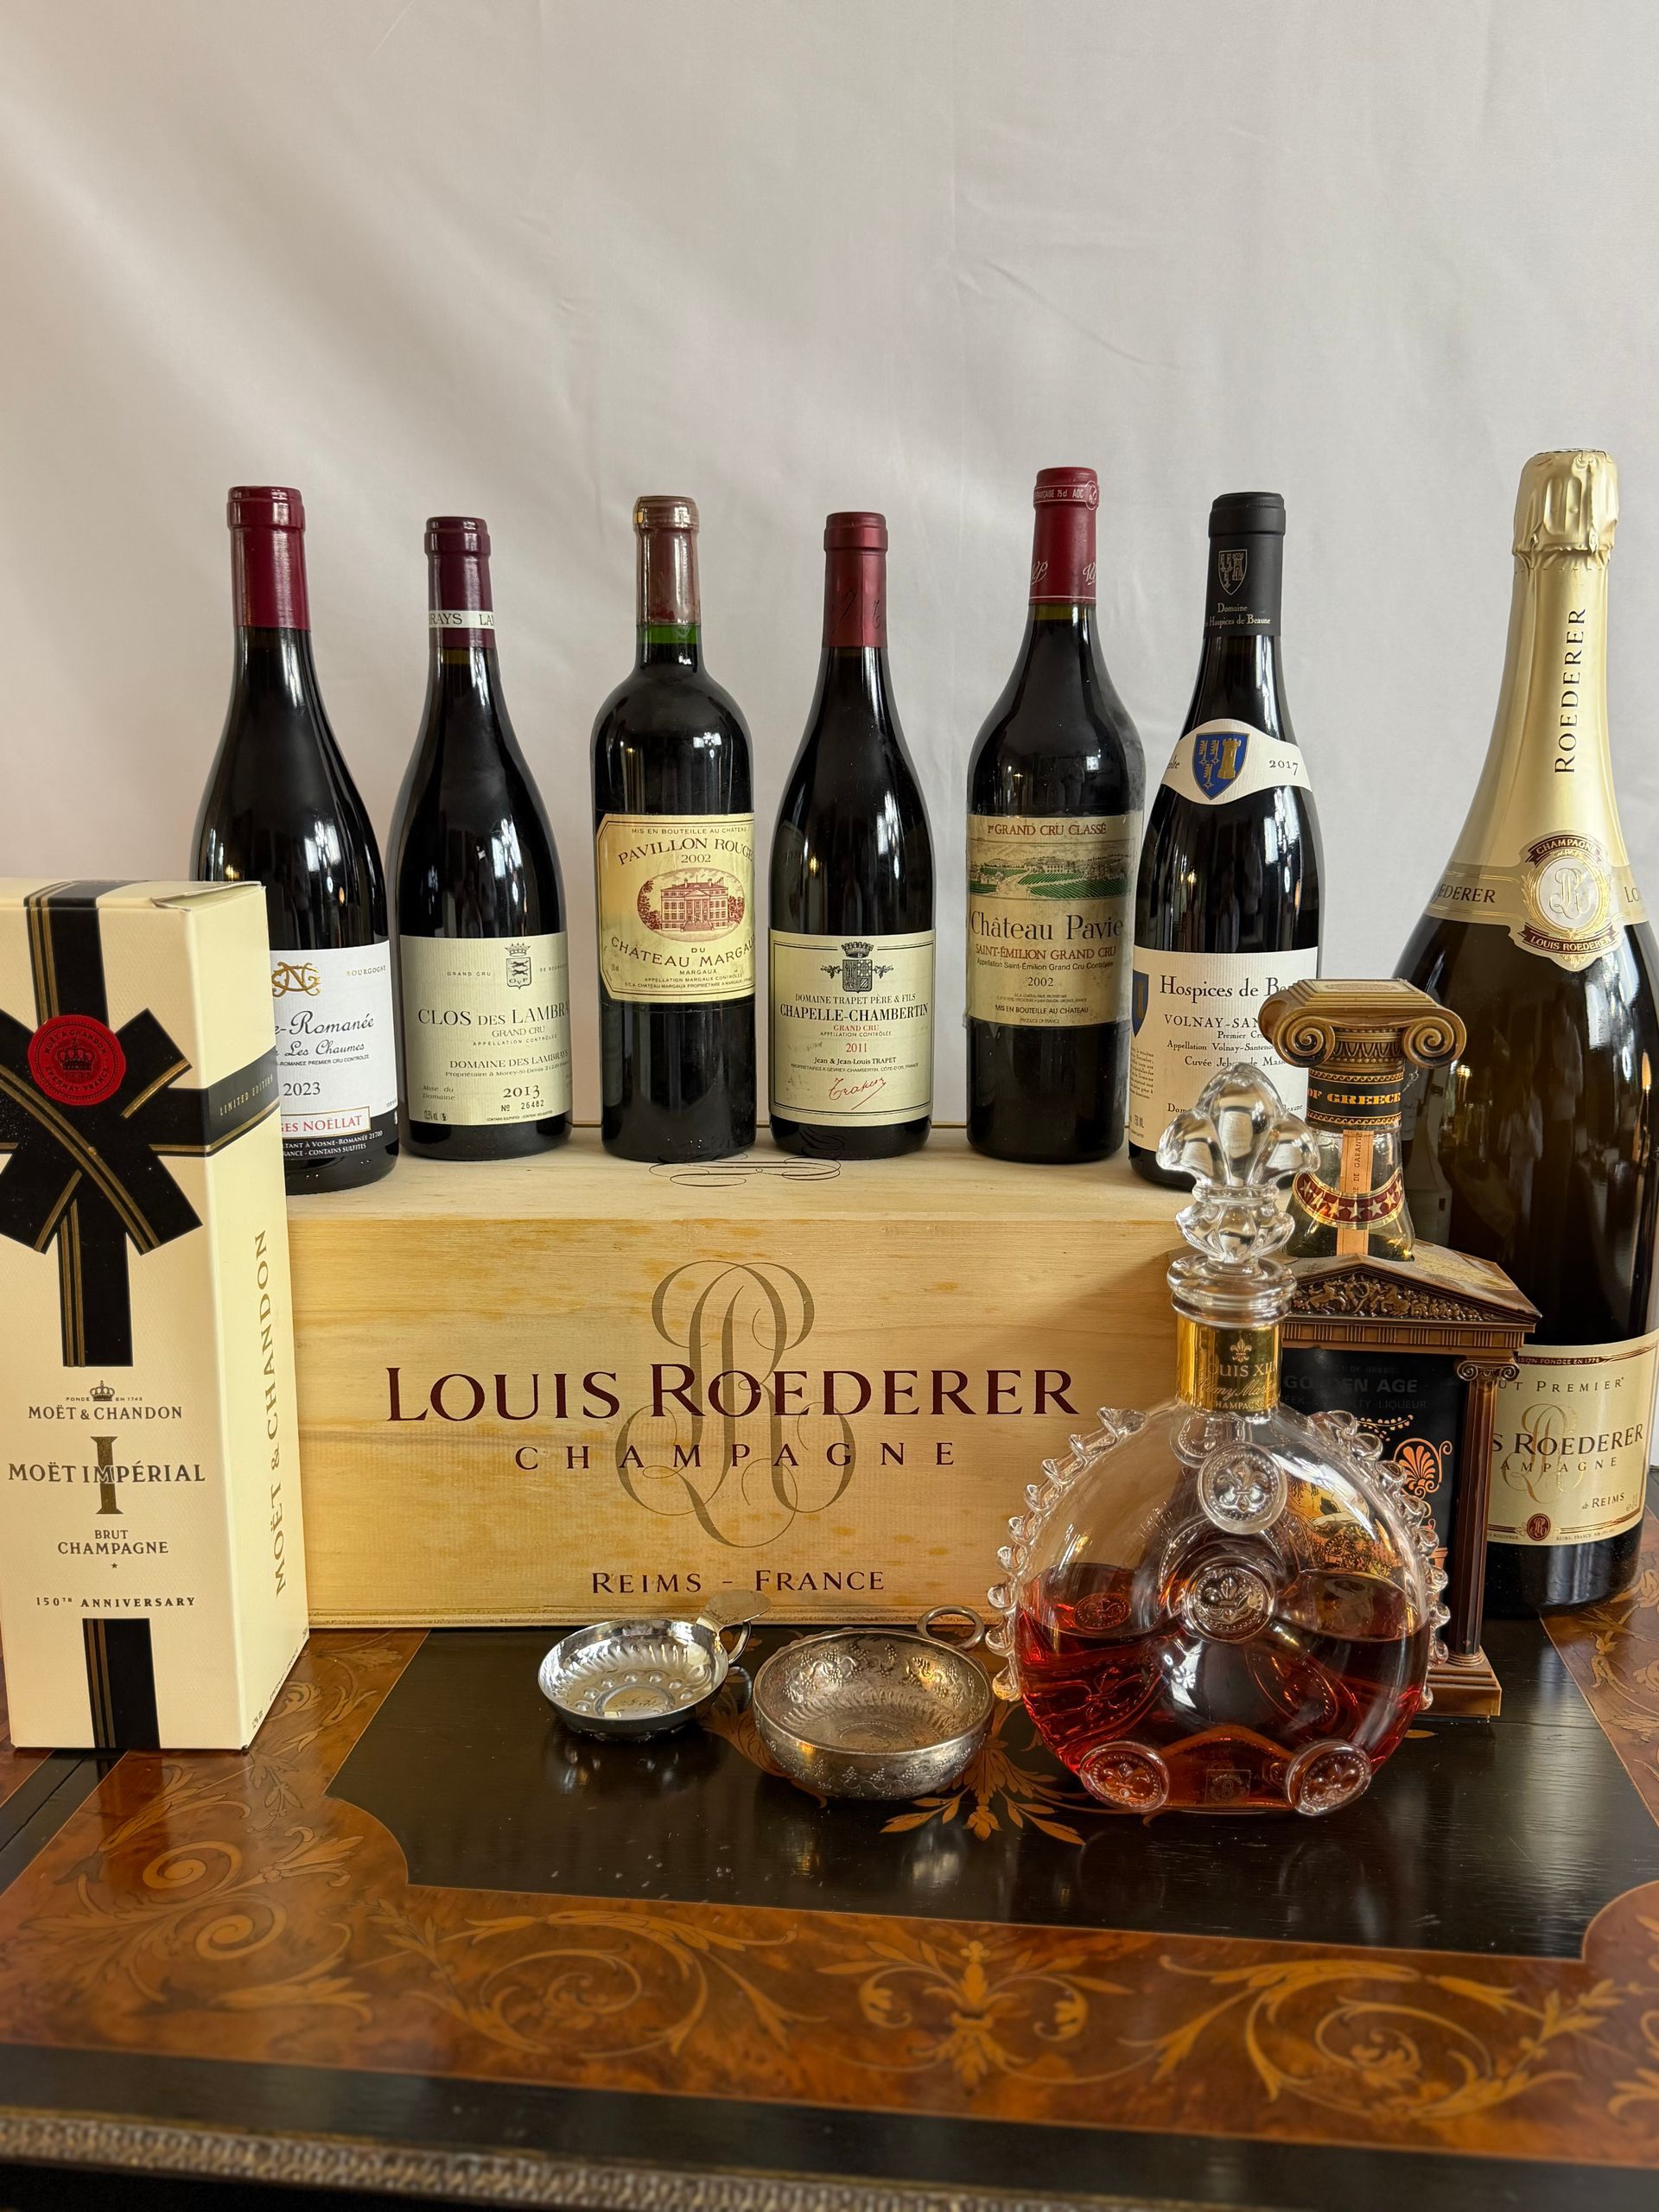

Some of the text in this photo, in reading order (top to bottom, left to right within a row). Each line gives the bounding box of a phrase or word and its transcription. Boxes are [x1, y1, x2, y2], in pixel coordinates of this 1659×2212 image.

[1072, 488, 1084, 499] AOC
[1217, 602, 1248, 613] Domaine
[1210, 613, 1271, 629] Hospices de Beaune
[1554, 608, 1586, 773] ROEDERER
[1268, 760, 1299, 777] 2017
[995, 821, 1107, 836] GRAND CRU CLASSÉ
[618, 837, 708, 866] PAVILLON
[1535, 837, 1600, 856] CHAMPAGNE
[681, 854, 711, 863] 2002
[971, 910, 1123, 941] Château Pavie
[1530, 935, 1611, 952] LOUIS ROEDERER
[976, 943, 1116, 960] SAINT-ÉMILION GRAND CRU
[977, 957, 1002, 969] Appellation
[1003, 962, 1047, 971] Saint-Émilion
[1027, 976, 1054, 987] 2002
[1159, 974, 1259, 1003] Hospices de
[795, 993, 832, 1004] DOMAINE
[833, 995, 868, 1005] TRAPET
[870, 994, 893, 1004] PÈRE
[902, 993, 917, 1002] FILS
[779, 1002, 929, 1022] CHAPELLE-CHAMBERTIN
[995, 1004, 1005, 1013] MIS
[1015, 1005, 1047, 1014] BOUTEILLE
[1048, 1006, 1058, 1014] AU
[418, 1007, 506, 1027] CLOS DES
[492, 1026, 546, 1038] GRAND CRU
[1217, 1030, 1246, 1039] Premier
[284, 1040, 309, 1057] Les
[315, 1039, 365, 1056] Chaumes
[845, 1042, 868, 1053] 2011
[1166, 1039, 1207, 1051] Appellation
[449, 1058, 506, 1069] DOMAINE
[509, 1058, 530, 1068] DES
[1185, 1055, 1212, 1067] Cuvée
[283, 1082, 321, 1096] 2023
[503, 1084, 540, 1099] 2013
[520, 1099, 544, 1110] 26482
[1326, 1091, 1401, 1106] GREECE
[303, 1115, 363, 1132] NOËLLAT
[311, 1135, 368, 1148] VOSNE-ROMANÉE
[369, 1129, 384, 1140] 21700
[308, 1147, 343, 1156] CONTAINS
[342, 1143, 366, 1154] SULFITES
[1353, 1173, 1361, 1182] DE
[385, 1361, 1080, 1422] LOUIS ROEDERER
[1376, 1378, 1418, 1393] AGE
[1536, 1376, 1621, 1393] PREMIER
[28, 1404, 182, 1420] MOËT & CHANDON
[254, 1230, 287, 1598] MOËT & CHANDON
[1514, 1423, 1644, 1456] ROEDERER
[514, 1441, 956, 1471] CHAMPAGNE
[8, 1460, 206, 1484] MOËT IMPÉRIAL
[1592, 1492, 1625, 1509] REIMS
[94, 1529, 129, 1540] BRUT
[58, 1541, 169, 1555] CHAMPAGNE
[590, 1567, 886, 1594] REIMS FRANCE
[80, 1597, 195, 1608] ANNIVERSARY
